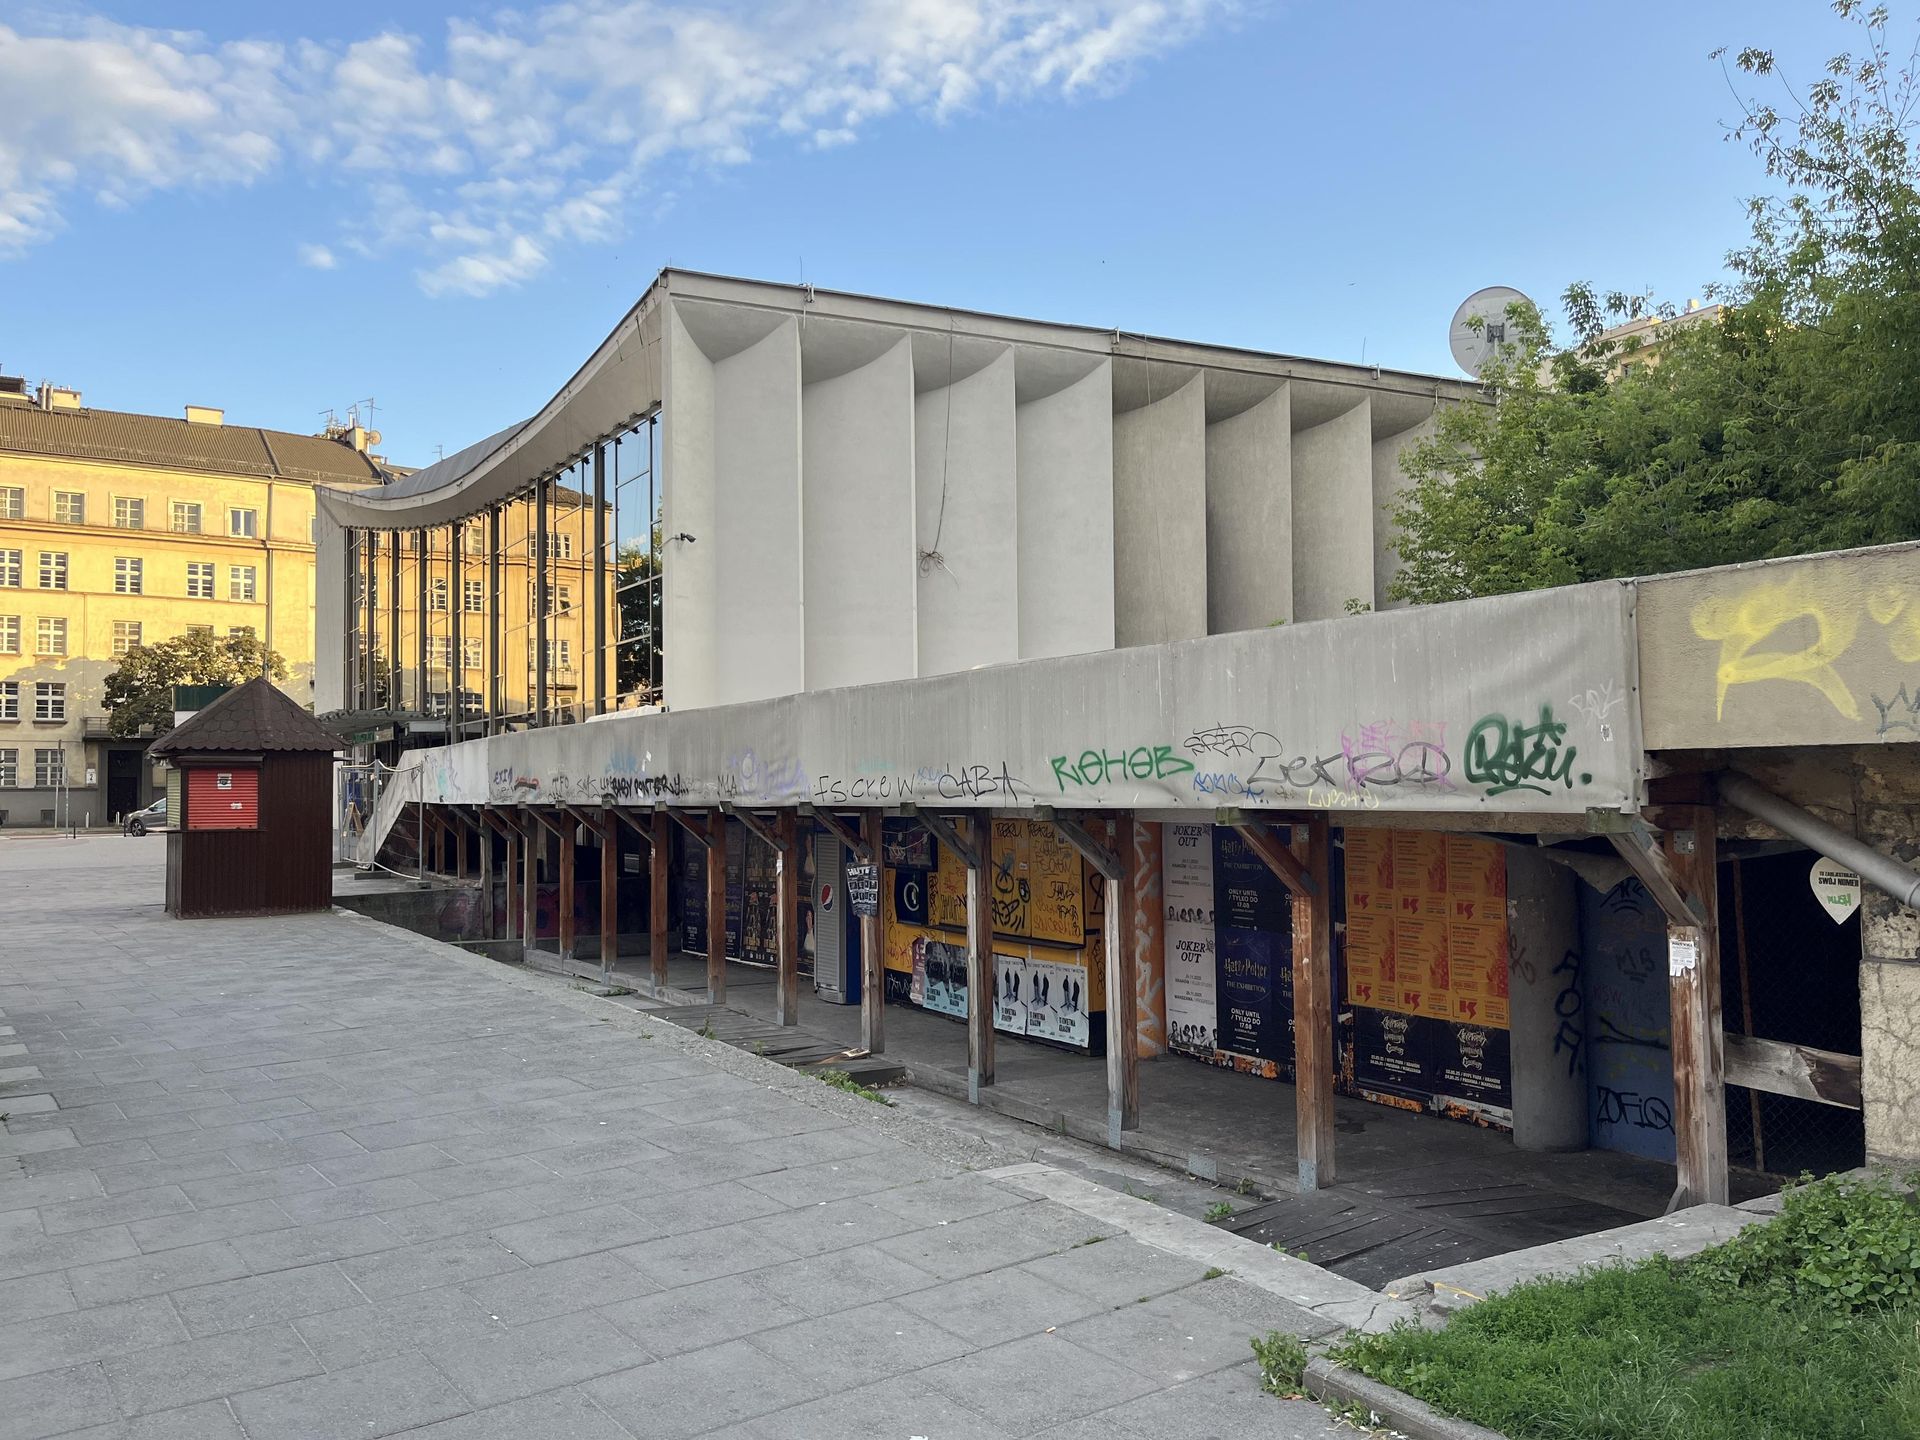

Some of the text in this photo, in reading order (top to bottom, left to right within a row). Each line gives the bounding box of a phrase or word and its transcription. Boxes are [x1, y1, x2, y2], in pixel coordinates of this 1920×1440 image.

[1173, 826, 1203, 837] JOKER
[1178, 837, 1198, 847] OUT
[1818, 877, 1859, 887] SWÓJ NUMER
[1229, 888, 1243, 896] ONLY
[1176, 940, 1205, 953] JOKER
[1181, 953, 1202, 963] OUT
[1225, 958, 1245, 977] Harry
[1245, 959, 1268, 979] Potter
[1237, 983, 1266, 993] EXHIBITION
[1231, 1008, 1261, 1019] ONLY UNTIL
[1235, 1015, 1252, 1024] TYLKO
[1252, 1017, 1261, 1025] DO
